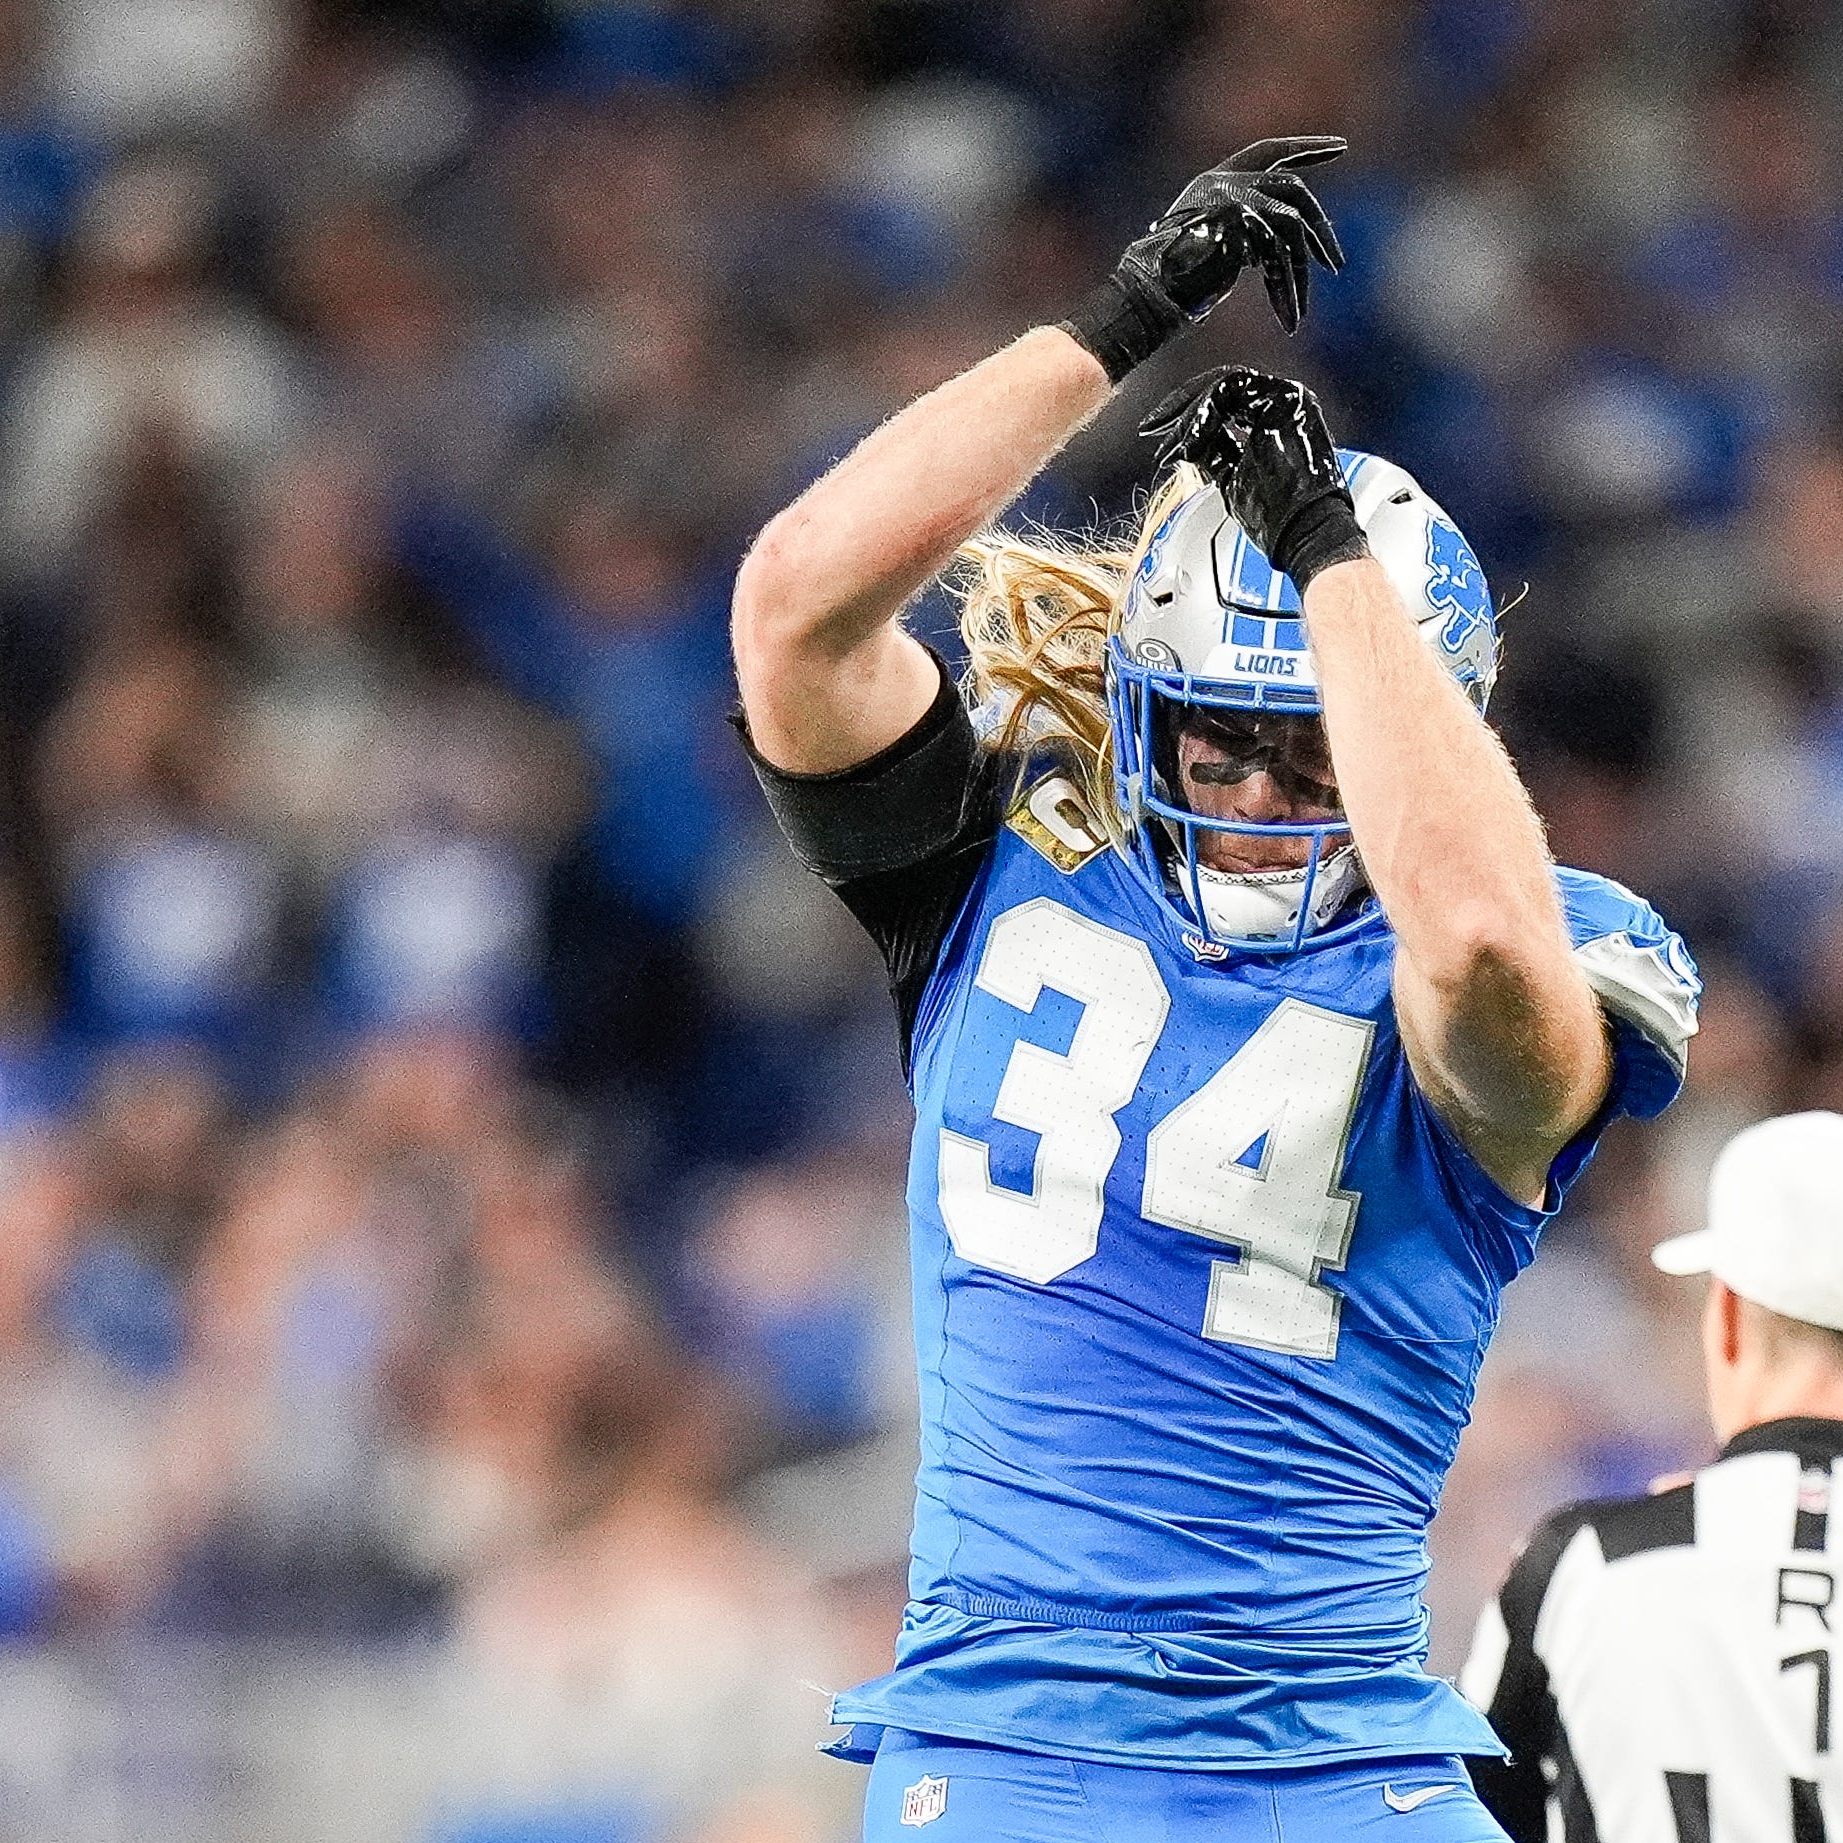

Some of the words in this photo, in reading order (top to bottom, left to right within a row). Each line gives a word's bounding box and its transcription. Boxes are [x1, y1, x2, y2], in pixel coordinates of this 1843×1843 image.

[1234, 652, 1298, 677] LIONS
[937, 896, 1376, 1360] 34
[1776, 1566, 1834, 1632] R
